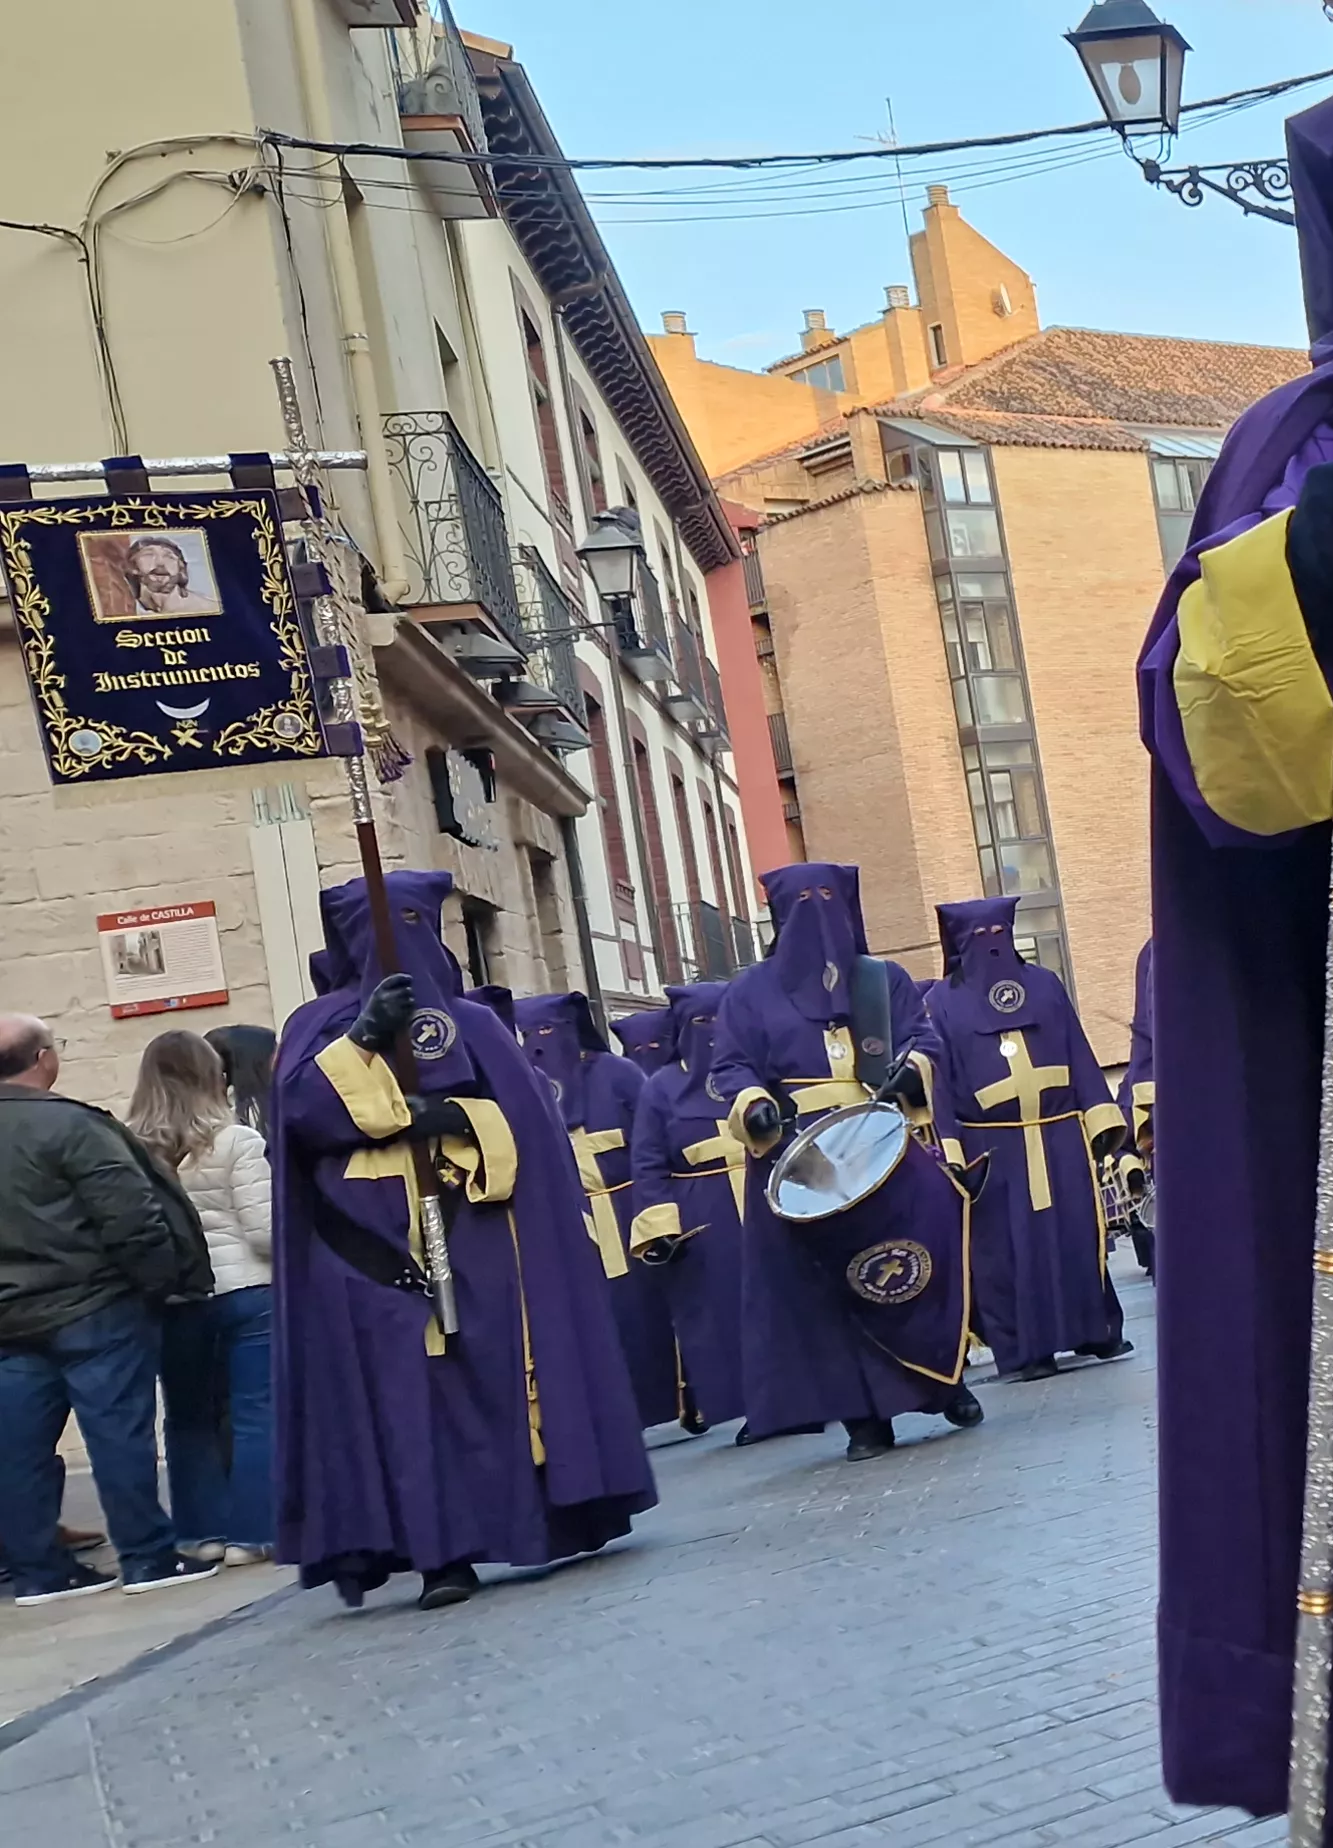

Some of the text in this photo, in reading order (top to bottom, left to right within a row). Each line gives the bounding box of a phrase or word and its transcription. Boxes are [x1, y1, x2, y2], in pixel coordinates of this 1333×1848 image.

[160, 647, 188, 666] de
[92, 661, 261, 692] Instrumentos
[151, 907, 194, 920] CASTILLA
